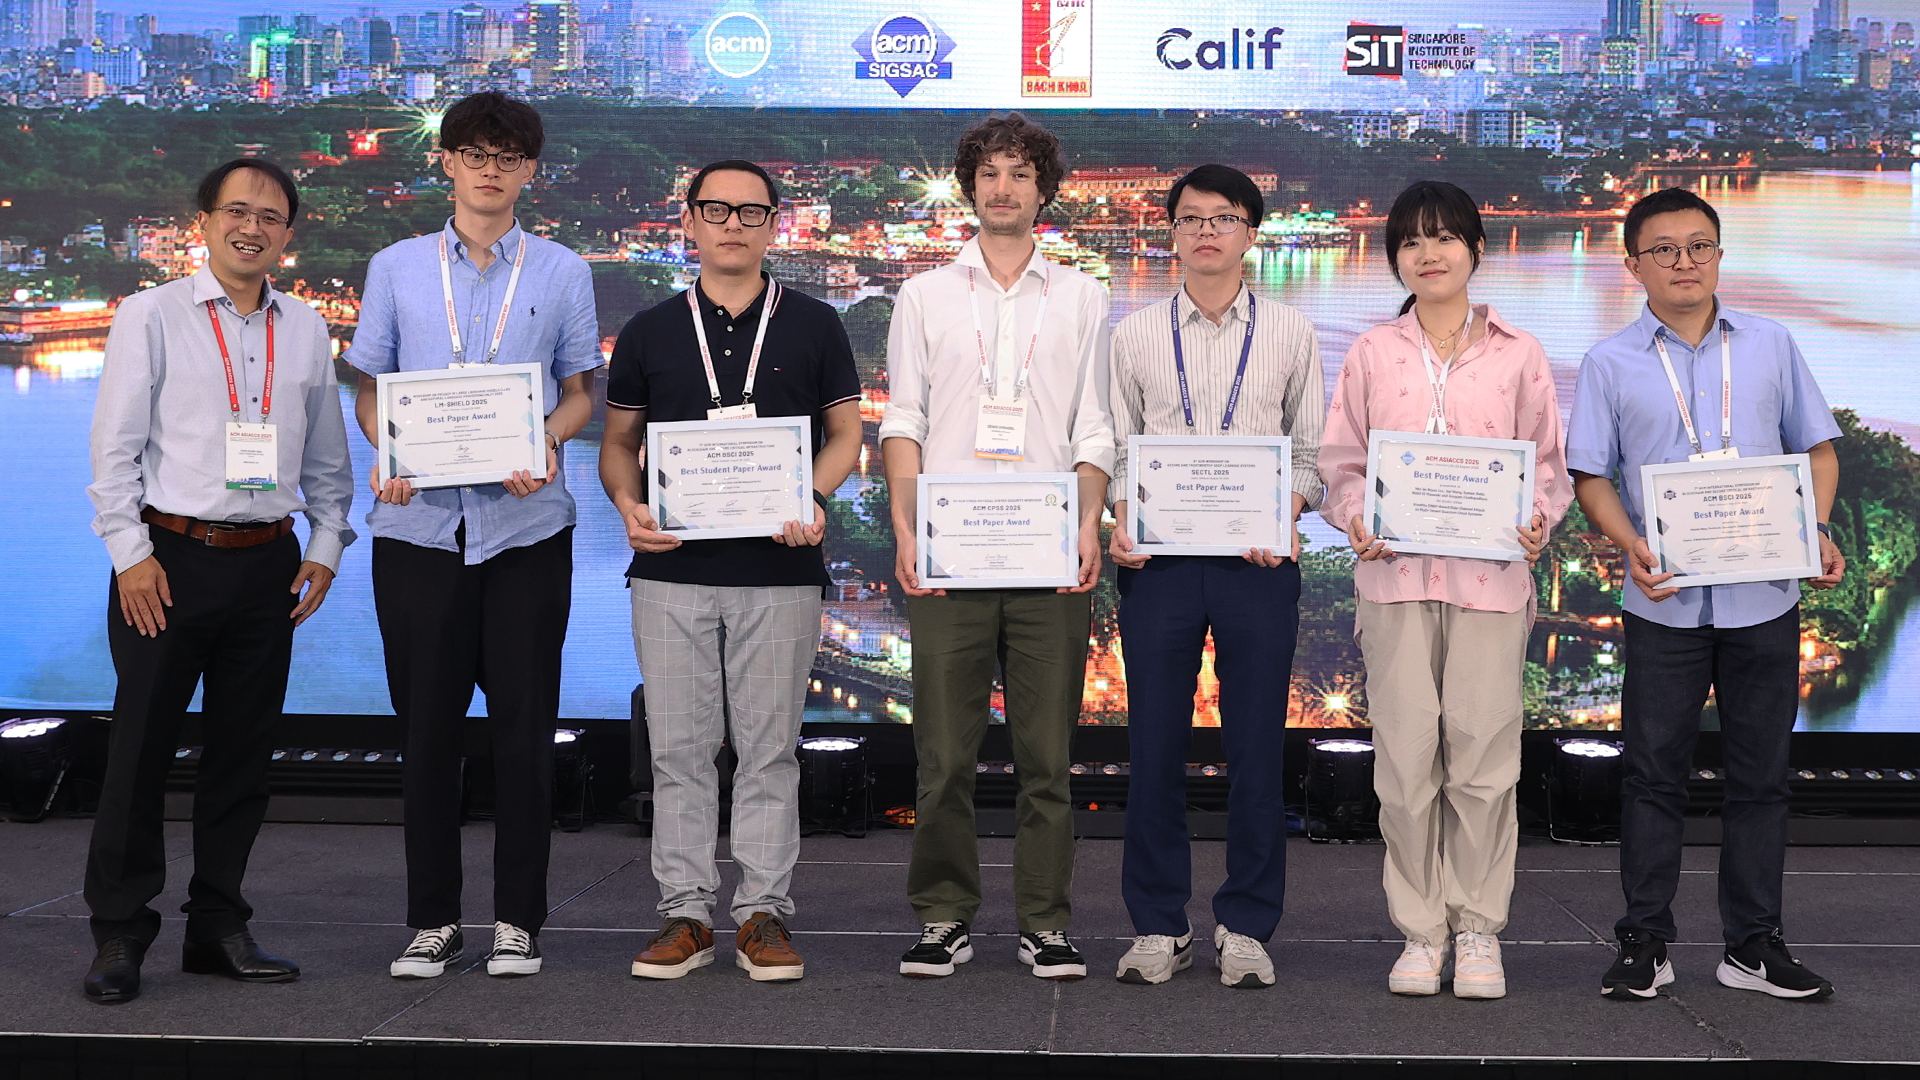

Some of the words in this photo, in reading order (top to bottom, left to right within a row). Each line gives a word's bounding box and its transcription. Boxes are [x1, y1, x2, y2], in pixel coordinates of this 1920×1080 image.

[712, 36, 764, 53] acm
[877, 35, 930, 53] acm
[1408, 34, 1465, 44] SINGAPORE
[1157, 27, 1284, 69] Calif
[1409, 46, 1459, 56] INSTITUTE
[1463, 46, 1475, 56] OF
[869, 63, 938, 78] SIGSAC
[1409, 59, 1475, 70] TECHNOLOGY
[1057, 82, 1087, 92] KHOA
[1026, 343, 1034, 360] ASIACCS
[225, 365, 234, 383] ASIACCS
[1230, 385, 1238, 403] ASIACCS
[435, 400, 470, 408] LM-SHIELD
[1679, 400, 1688, 418] ASIACCS
[733, 465, 754, 473] Paper
[1414, 471, 1432, 479] Best
[1435, 472, 1460, 481] Poster
[1463, 475, 1488, 483] Award
[1196, 484, 1217, 492] Paper
[1714, 510, 1736, 518] Paper
[1739, 507, 1764, 515] Award
